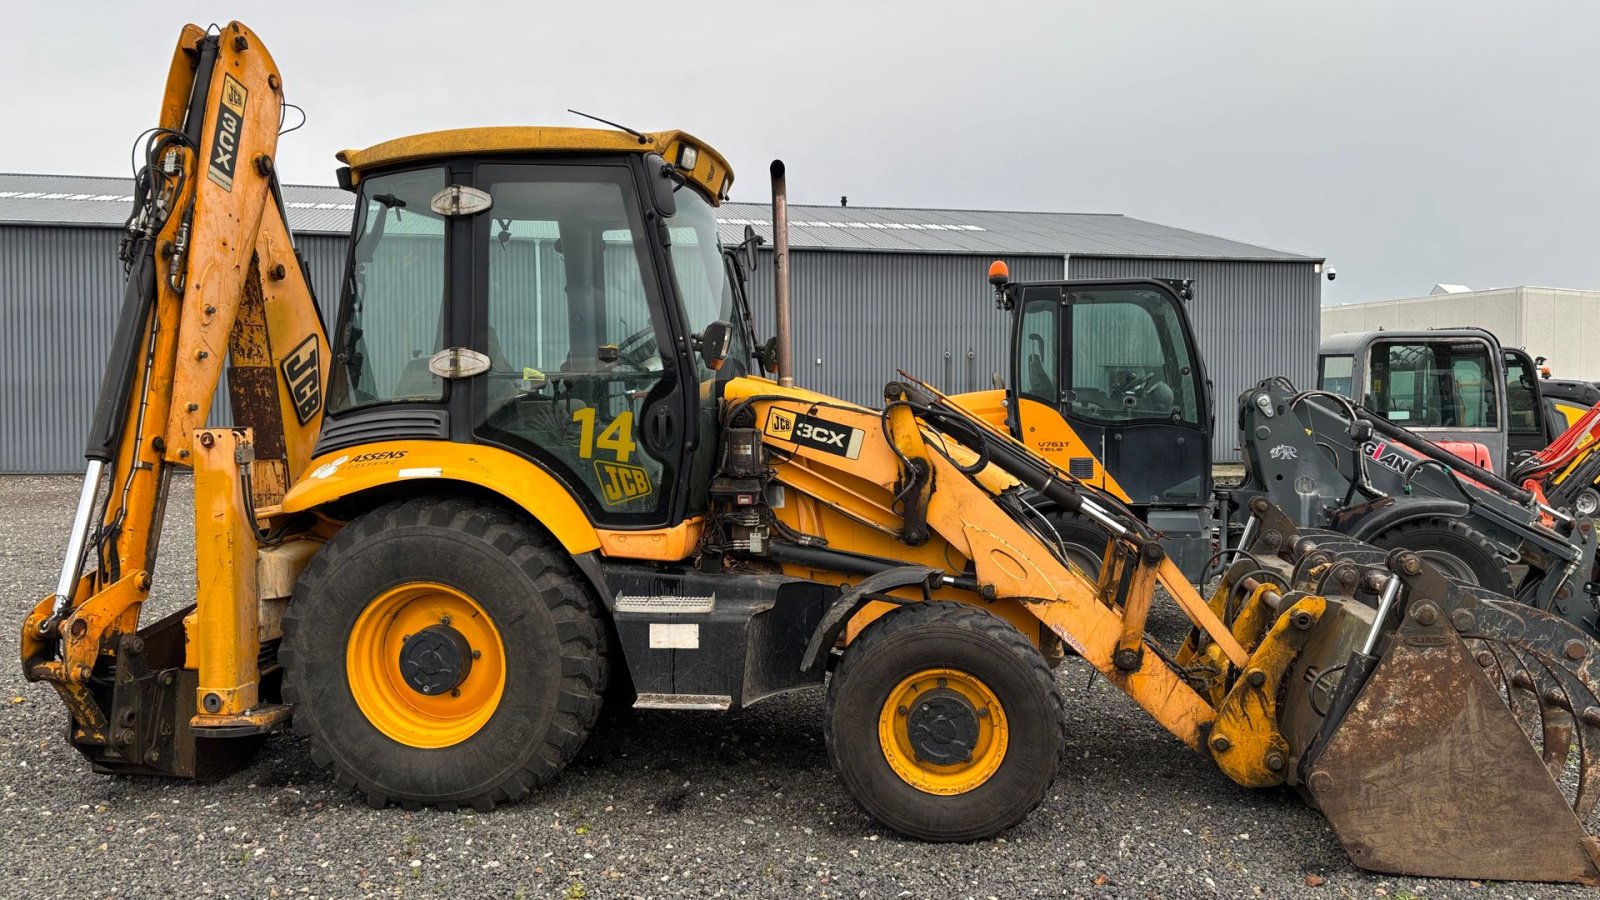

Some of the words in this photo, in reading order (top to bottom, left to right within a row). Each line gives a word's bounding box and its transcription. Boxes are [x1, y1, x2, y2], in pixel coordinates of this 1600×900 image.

[215, 112, 237, 171] 3CX
[287, 349, 319, 418] JCB
[573, 407, 636, 462] 14
[773, 416, 790, 430] JCB
[796, 423, 846, 447] 3CX
[349, 450, 408, 464] ASSENS
[604, 465, 649, 500] JCB
